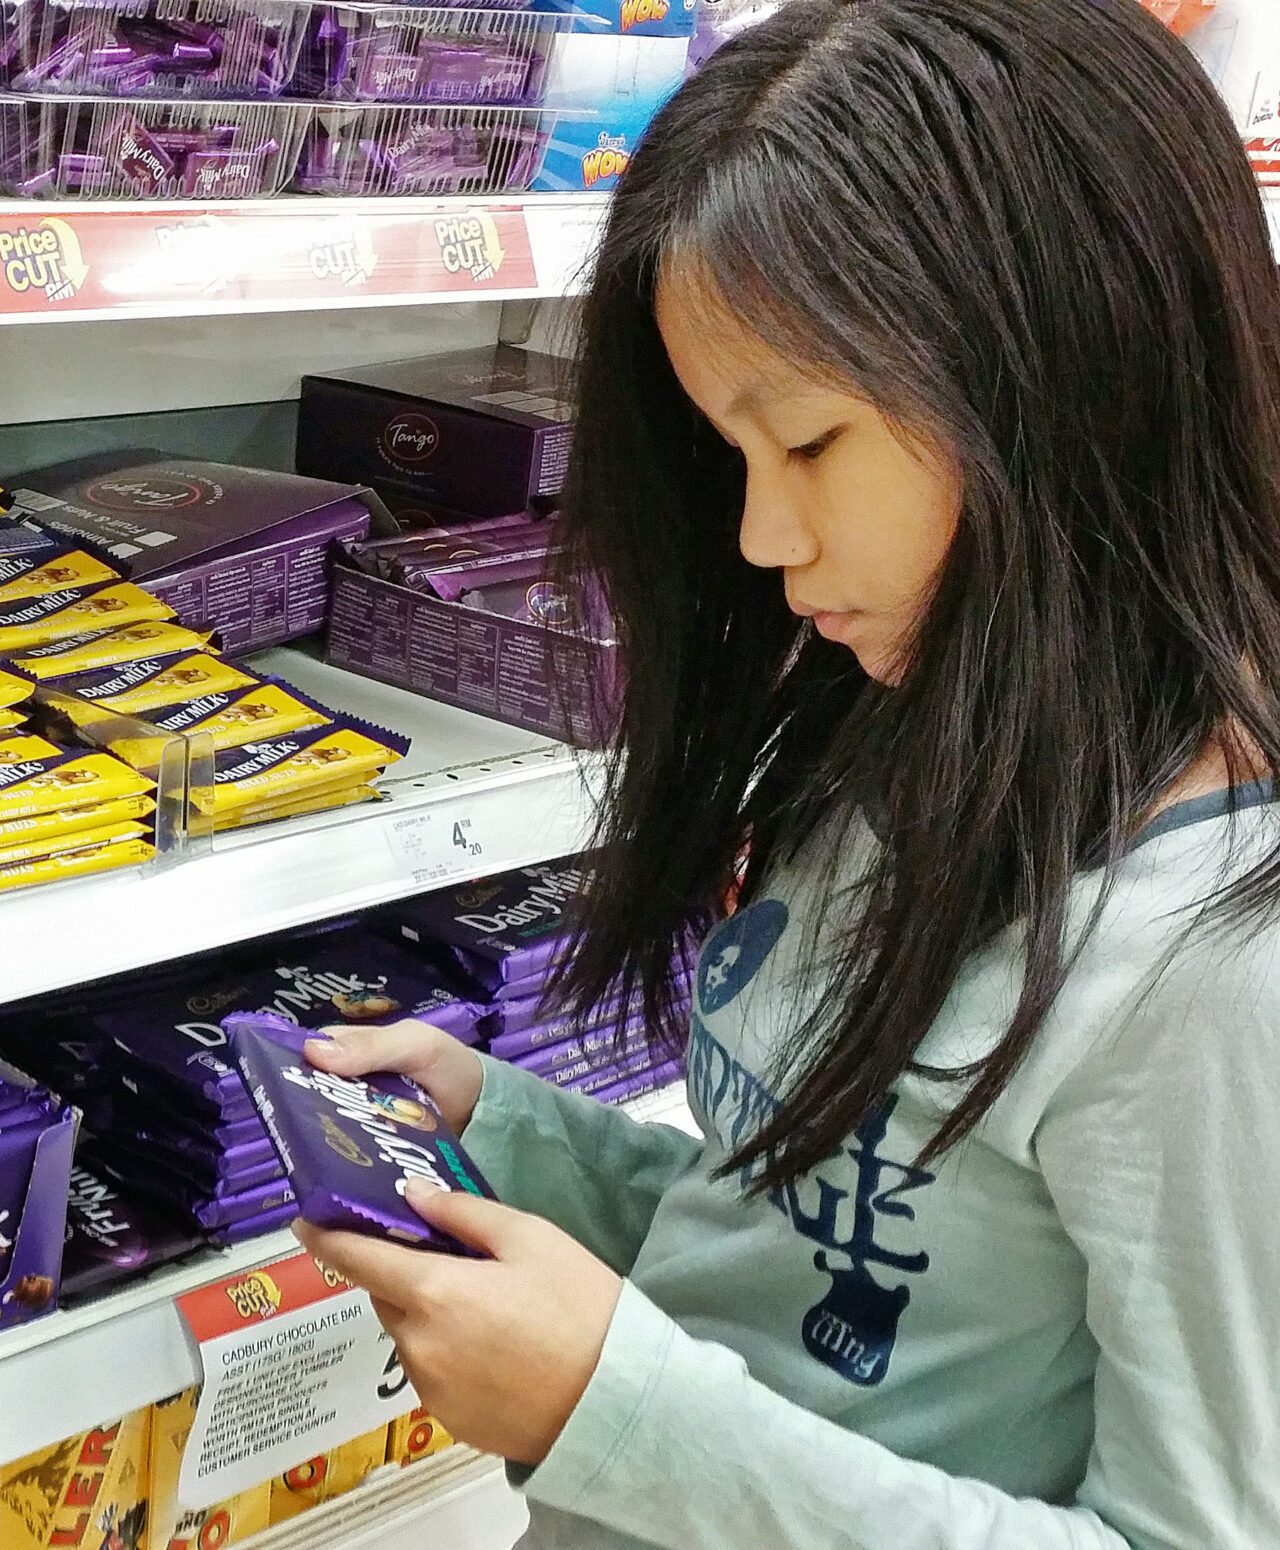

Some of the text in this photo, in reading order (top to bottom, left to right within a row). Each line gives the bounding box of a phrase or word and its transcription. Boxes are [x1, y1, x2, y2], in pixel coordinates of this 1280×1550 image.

[435, 217, 482, 248] Price
[5, 254, 61, 291] CUT
[442, 242, 487, 274] CUT
[388, 423, 435, 450] Tango
[41, 589, 82, 613] MILK
[27, 641, 75, 658] DAIRY
[76, 660, 161, 699] DAIRY MILK
[187, 694, 229, 721] MILK
[214, 740, 299, 783] DAIRY MILK
[6, 818, 38, 834] NUTS
[452, 822, 466, 848] 4
[2, 864, 34, 879] NUTS
[455, 890, 561, 933] Dairy
[222, 1306, 362, 1365] CADBURY CHOCOLATE BAR
[222, 1362, 250, 1382] ASST
[243, 1407, 317, 1444] REDEMPTION AT
[266, 1413, 276, 1423] IN
[197, 1450, 251, 1478] CUSTOMER
[253, 1431, 292, 1455] SERVICE
[294, 1410, 337, 1437] COUNTER
